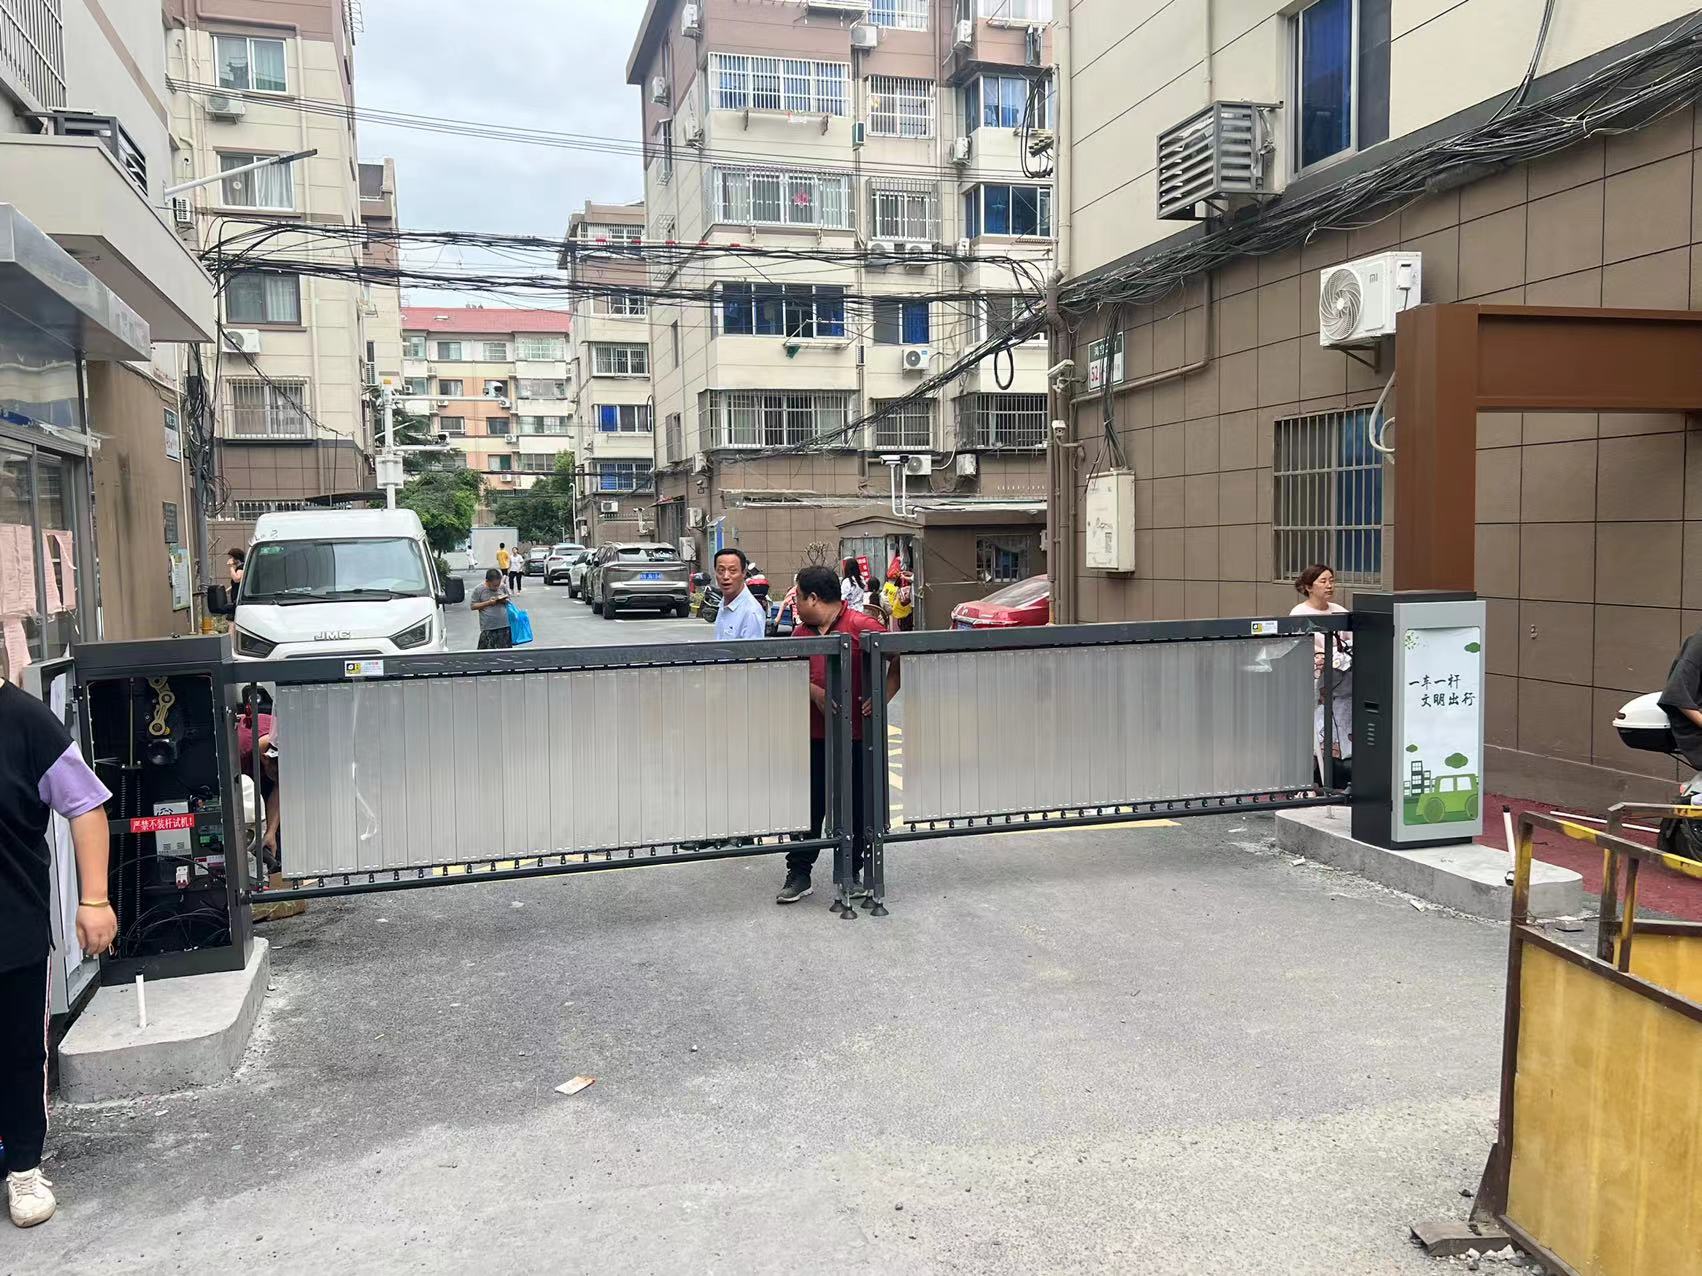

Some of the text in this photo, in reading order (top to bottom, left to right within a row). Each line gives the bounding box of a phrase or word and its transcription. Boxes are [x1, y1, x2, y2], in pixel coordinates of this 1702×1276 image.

[314, 631, 351, 641] JMC
[1409, 674, 1461, 690] 一车一杆
[1421, 692, 1475, 707] 文明出行
